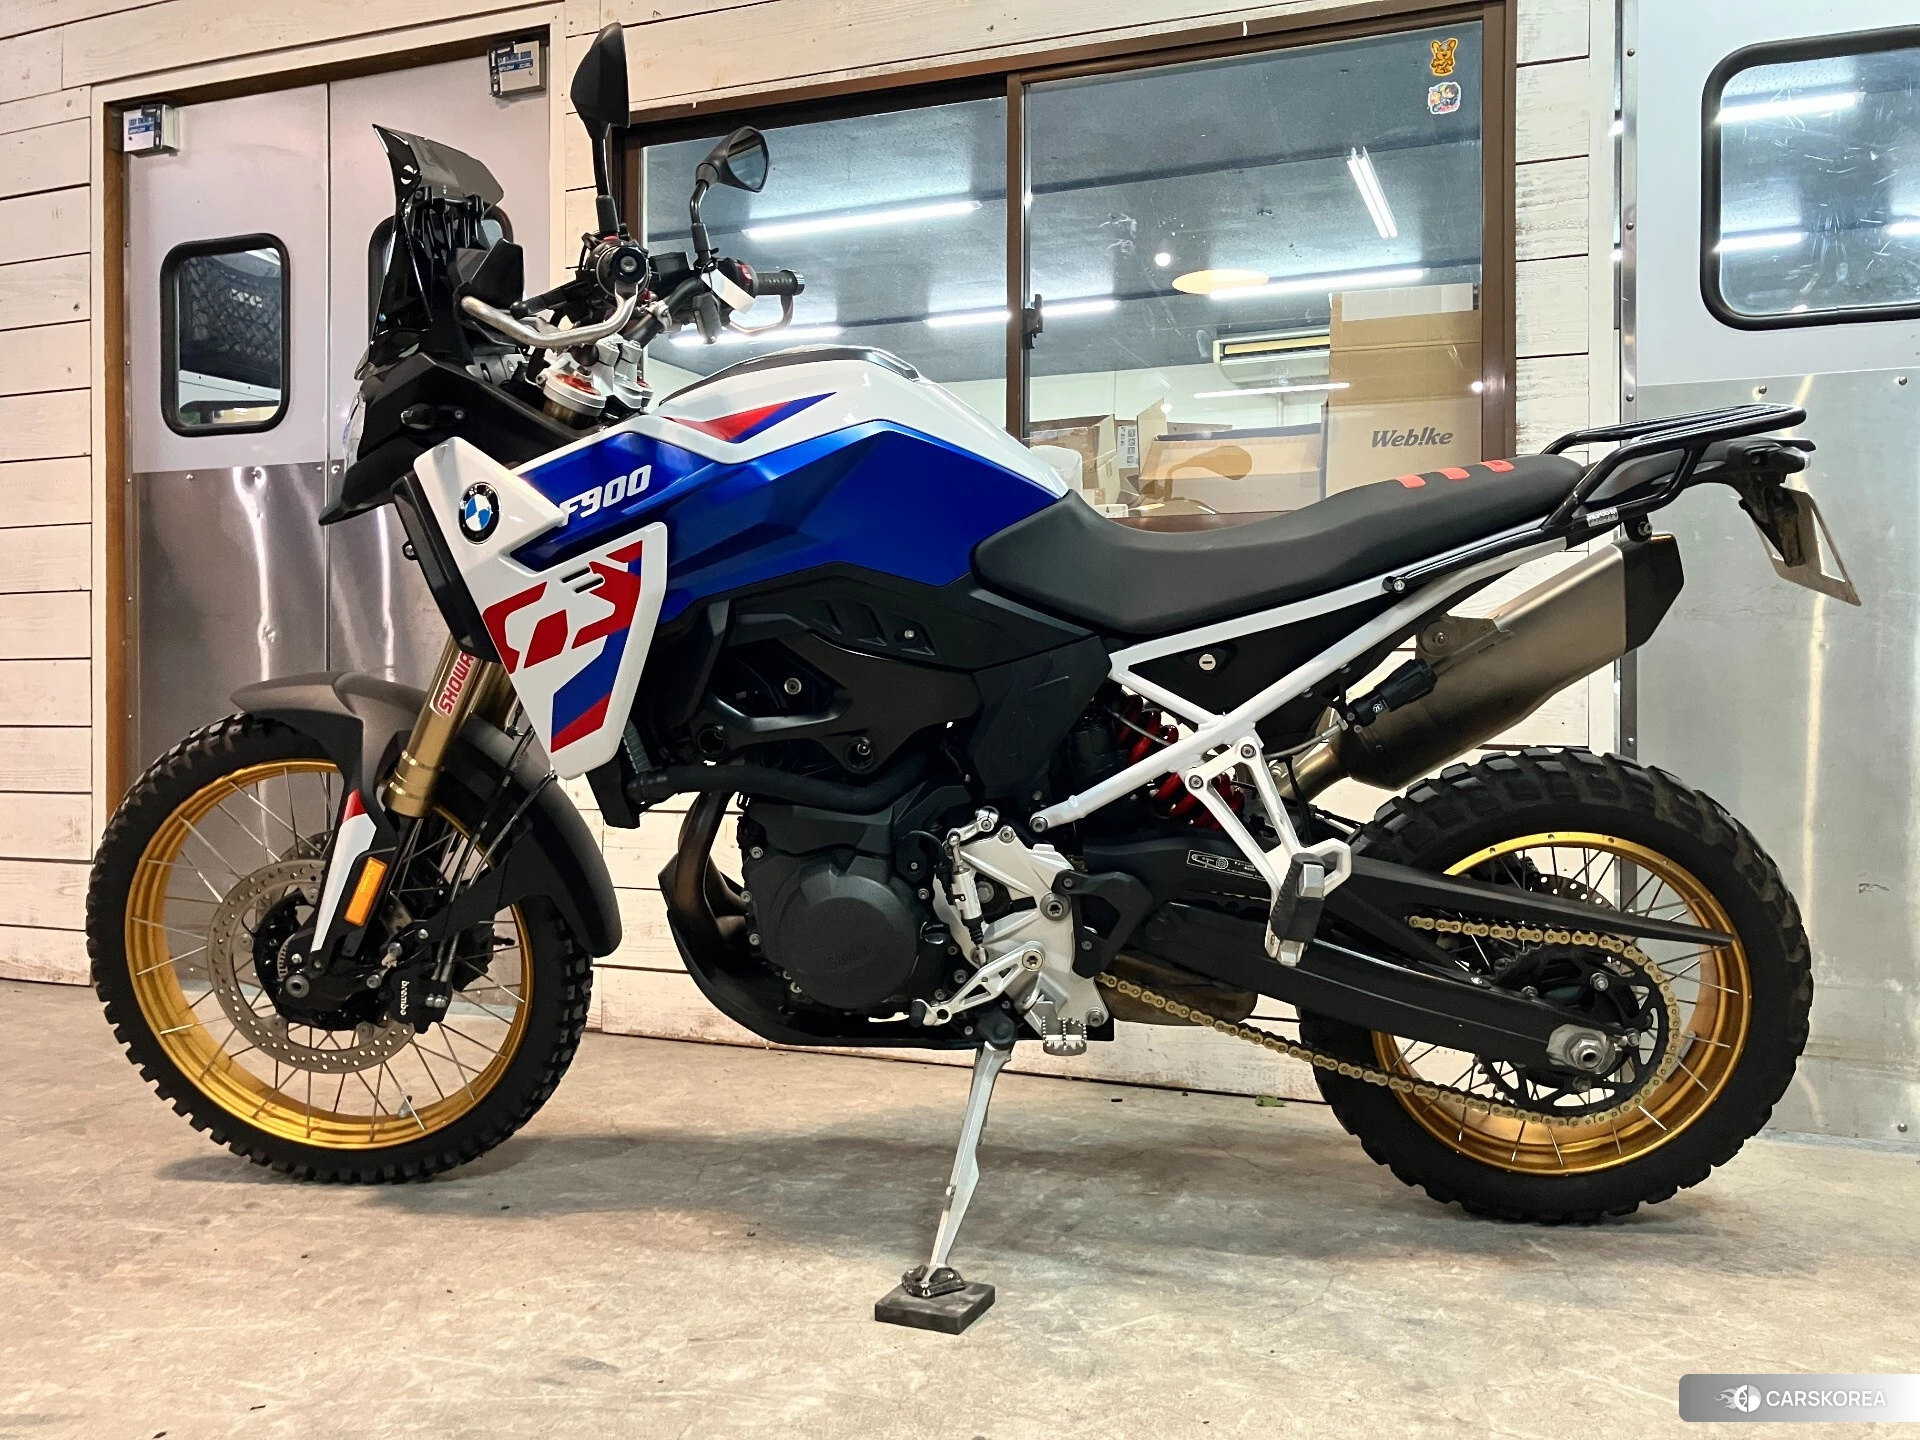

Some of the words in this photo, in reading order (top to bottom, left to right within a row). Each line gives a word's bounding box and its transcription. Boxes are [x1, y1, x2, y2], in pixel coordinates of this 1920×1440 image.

[559, 464, 652, 528] F900
[438, 651, 475, 715] SHOWA
[400, 980, 410, 1016] brembo
